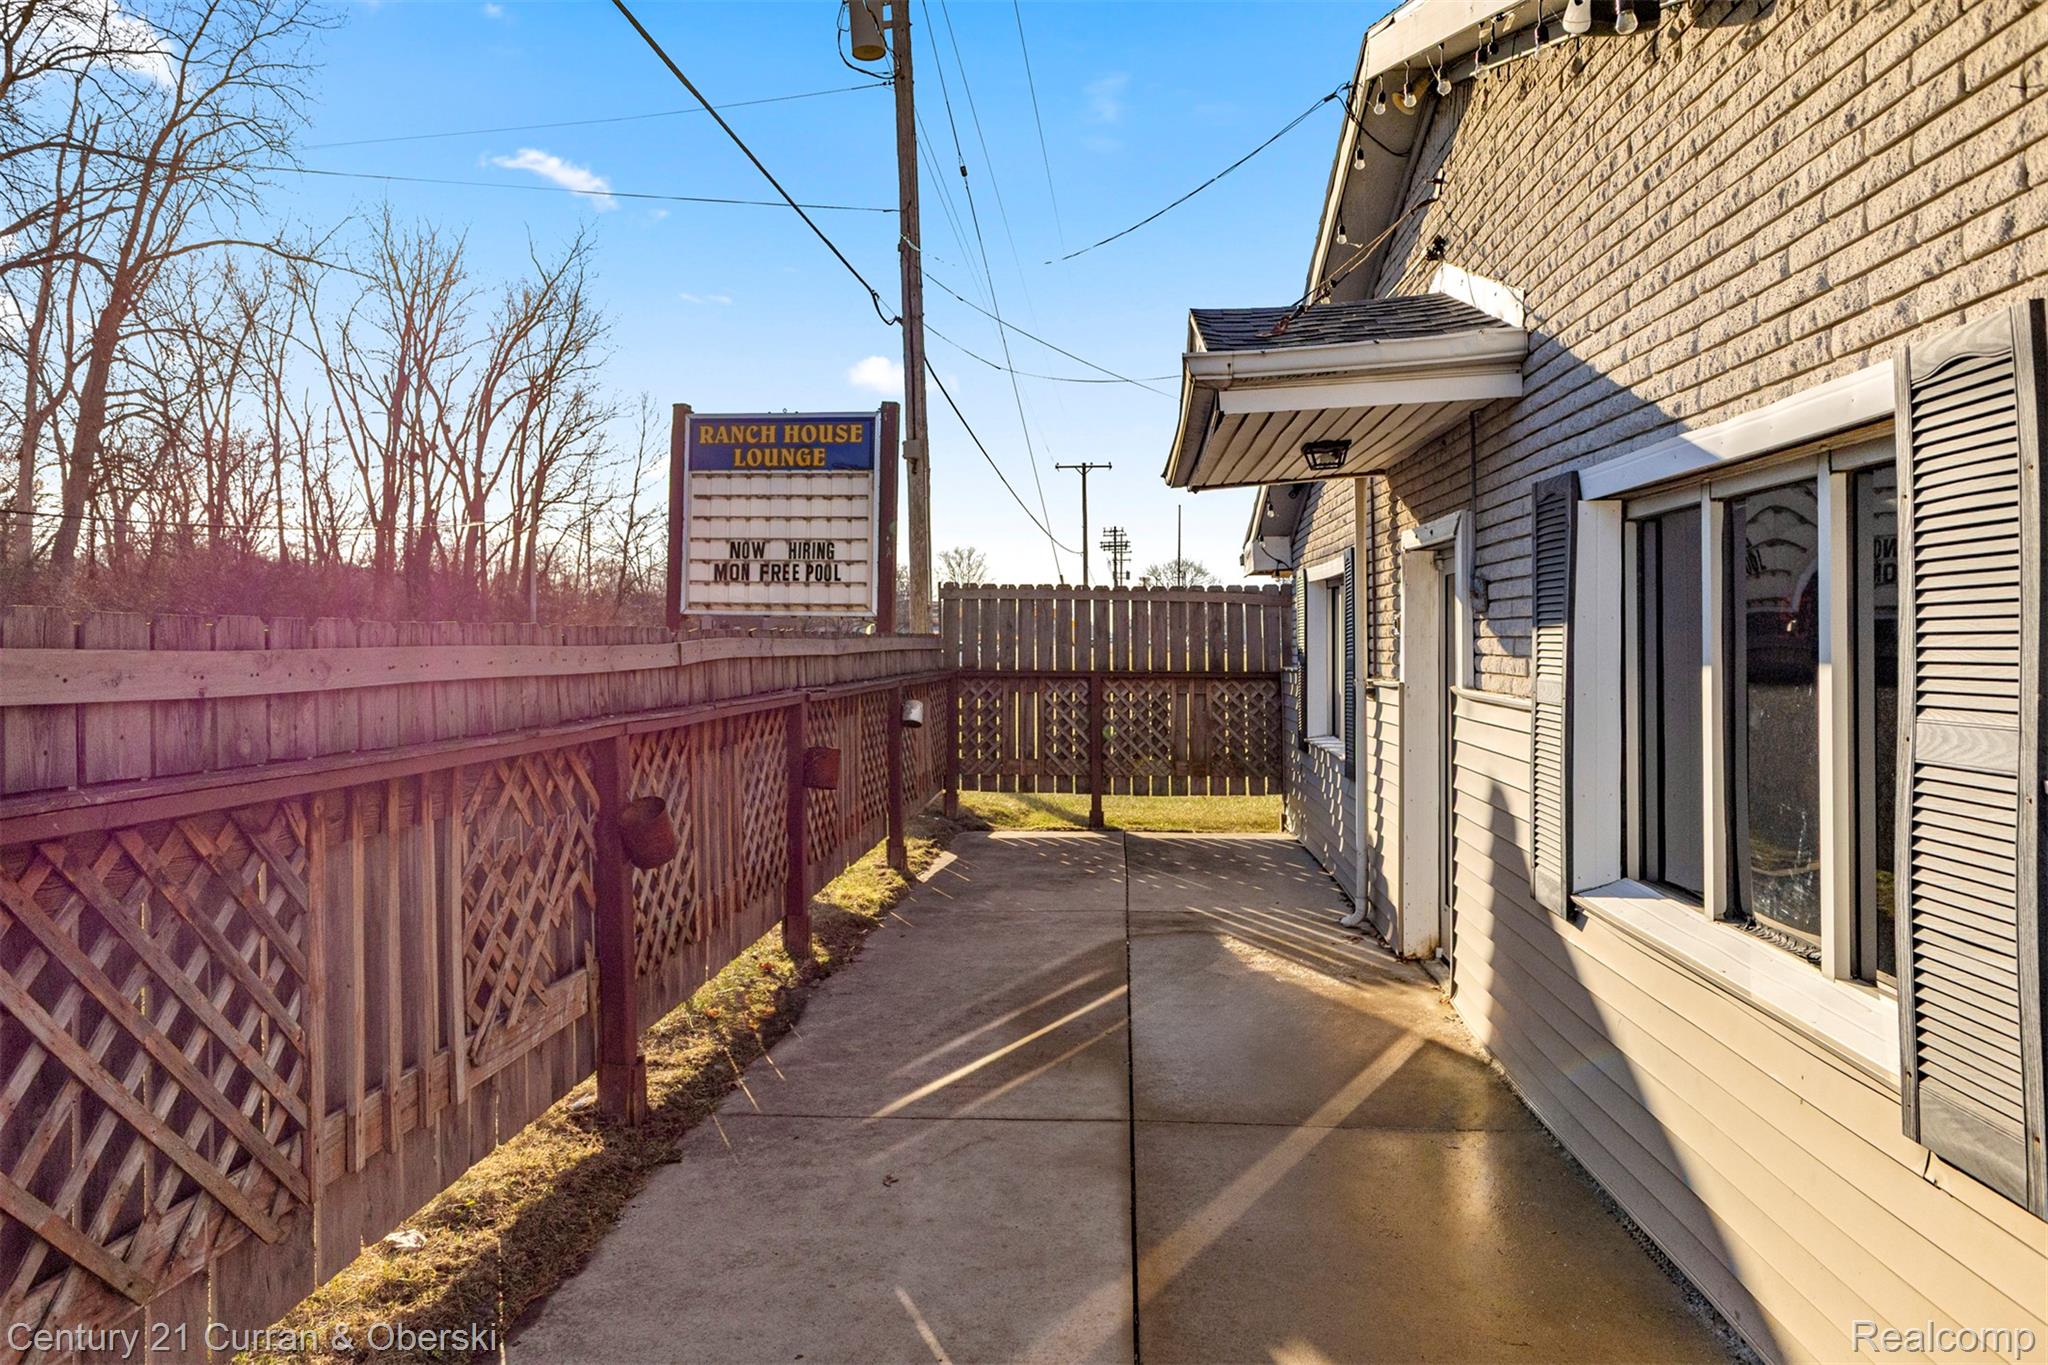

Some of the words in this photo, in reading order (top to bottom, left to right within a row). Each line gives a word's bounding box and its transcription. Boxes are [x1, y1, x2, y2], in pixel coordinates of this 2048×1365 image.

[699, 424, 776, 444] RANCH
[784, 424, 864, 443] HOUSE
[733, 448, 827, 467] LOUNGE
[729, 542, 766, 559] NOW
[788, 542, 835, 560] HIRING
[713, 563, 750, 581] MON
[759, 563, 800, 582] FREE
[805, 563, 841, 581] POOL
